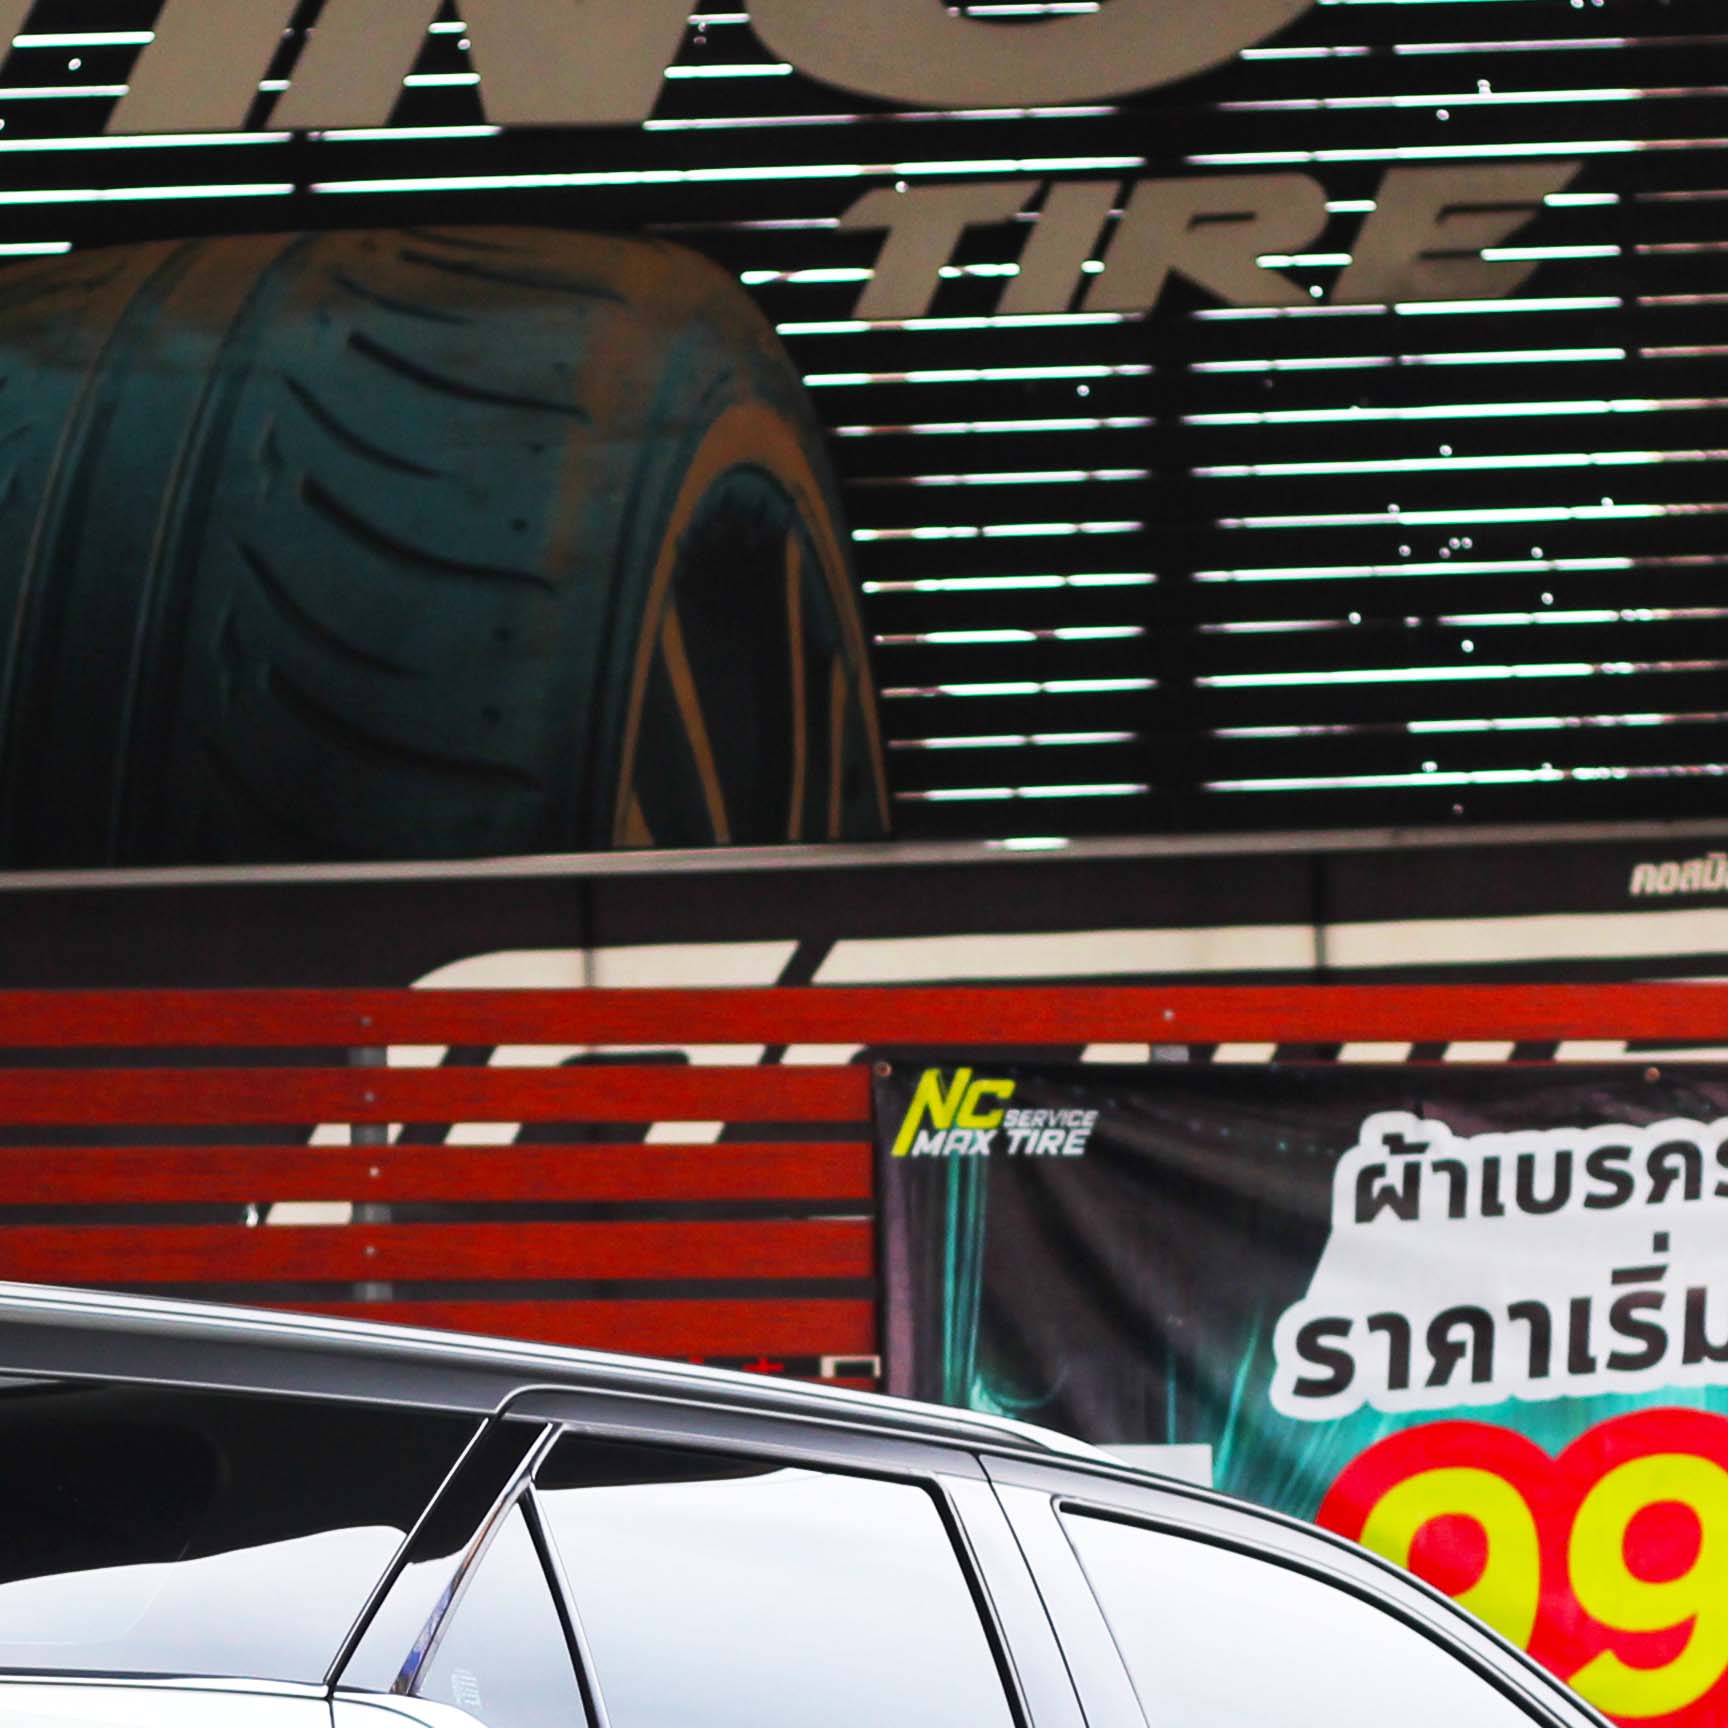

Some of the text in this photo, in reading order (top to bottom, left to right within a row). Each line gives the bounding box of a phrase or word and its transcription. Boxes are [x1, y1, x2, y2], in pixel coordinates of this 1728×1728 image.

[834, 158, 1586, 321] TIRE
[891, 1067, 1099, 1157] NC SERVICE
[911, 1128, 1091, 1157] MAX TIRE
